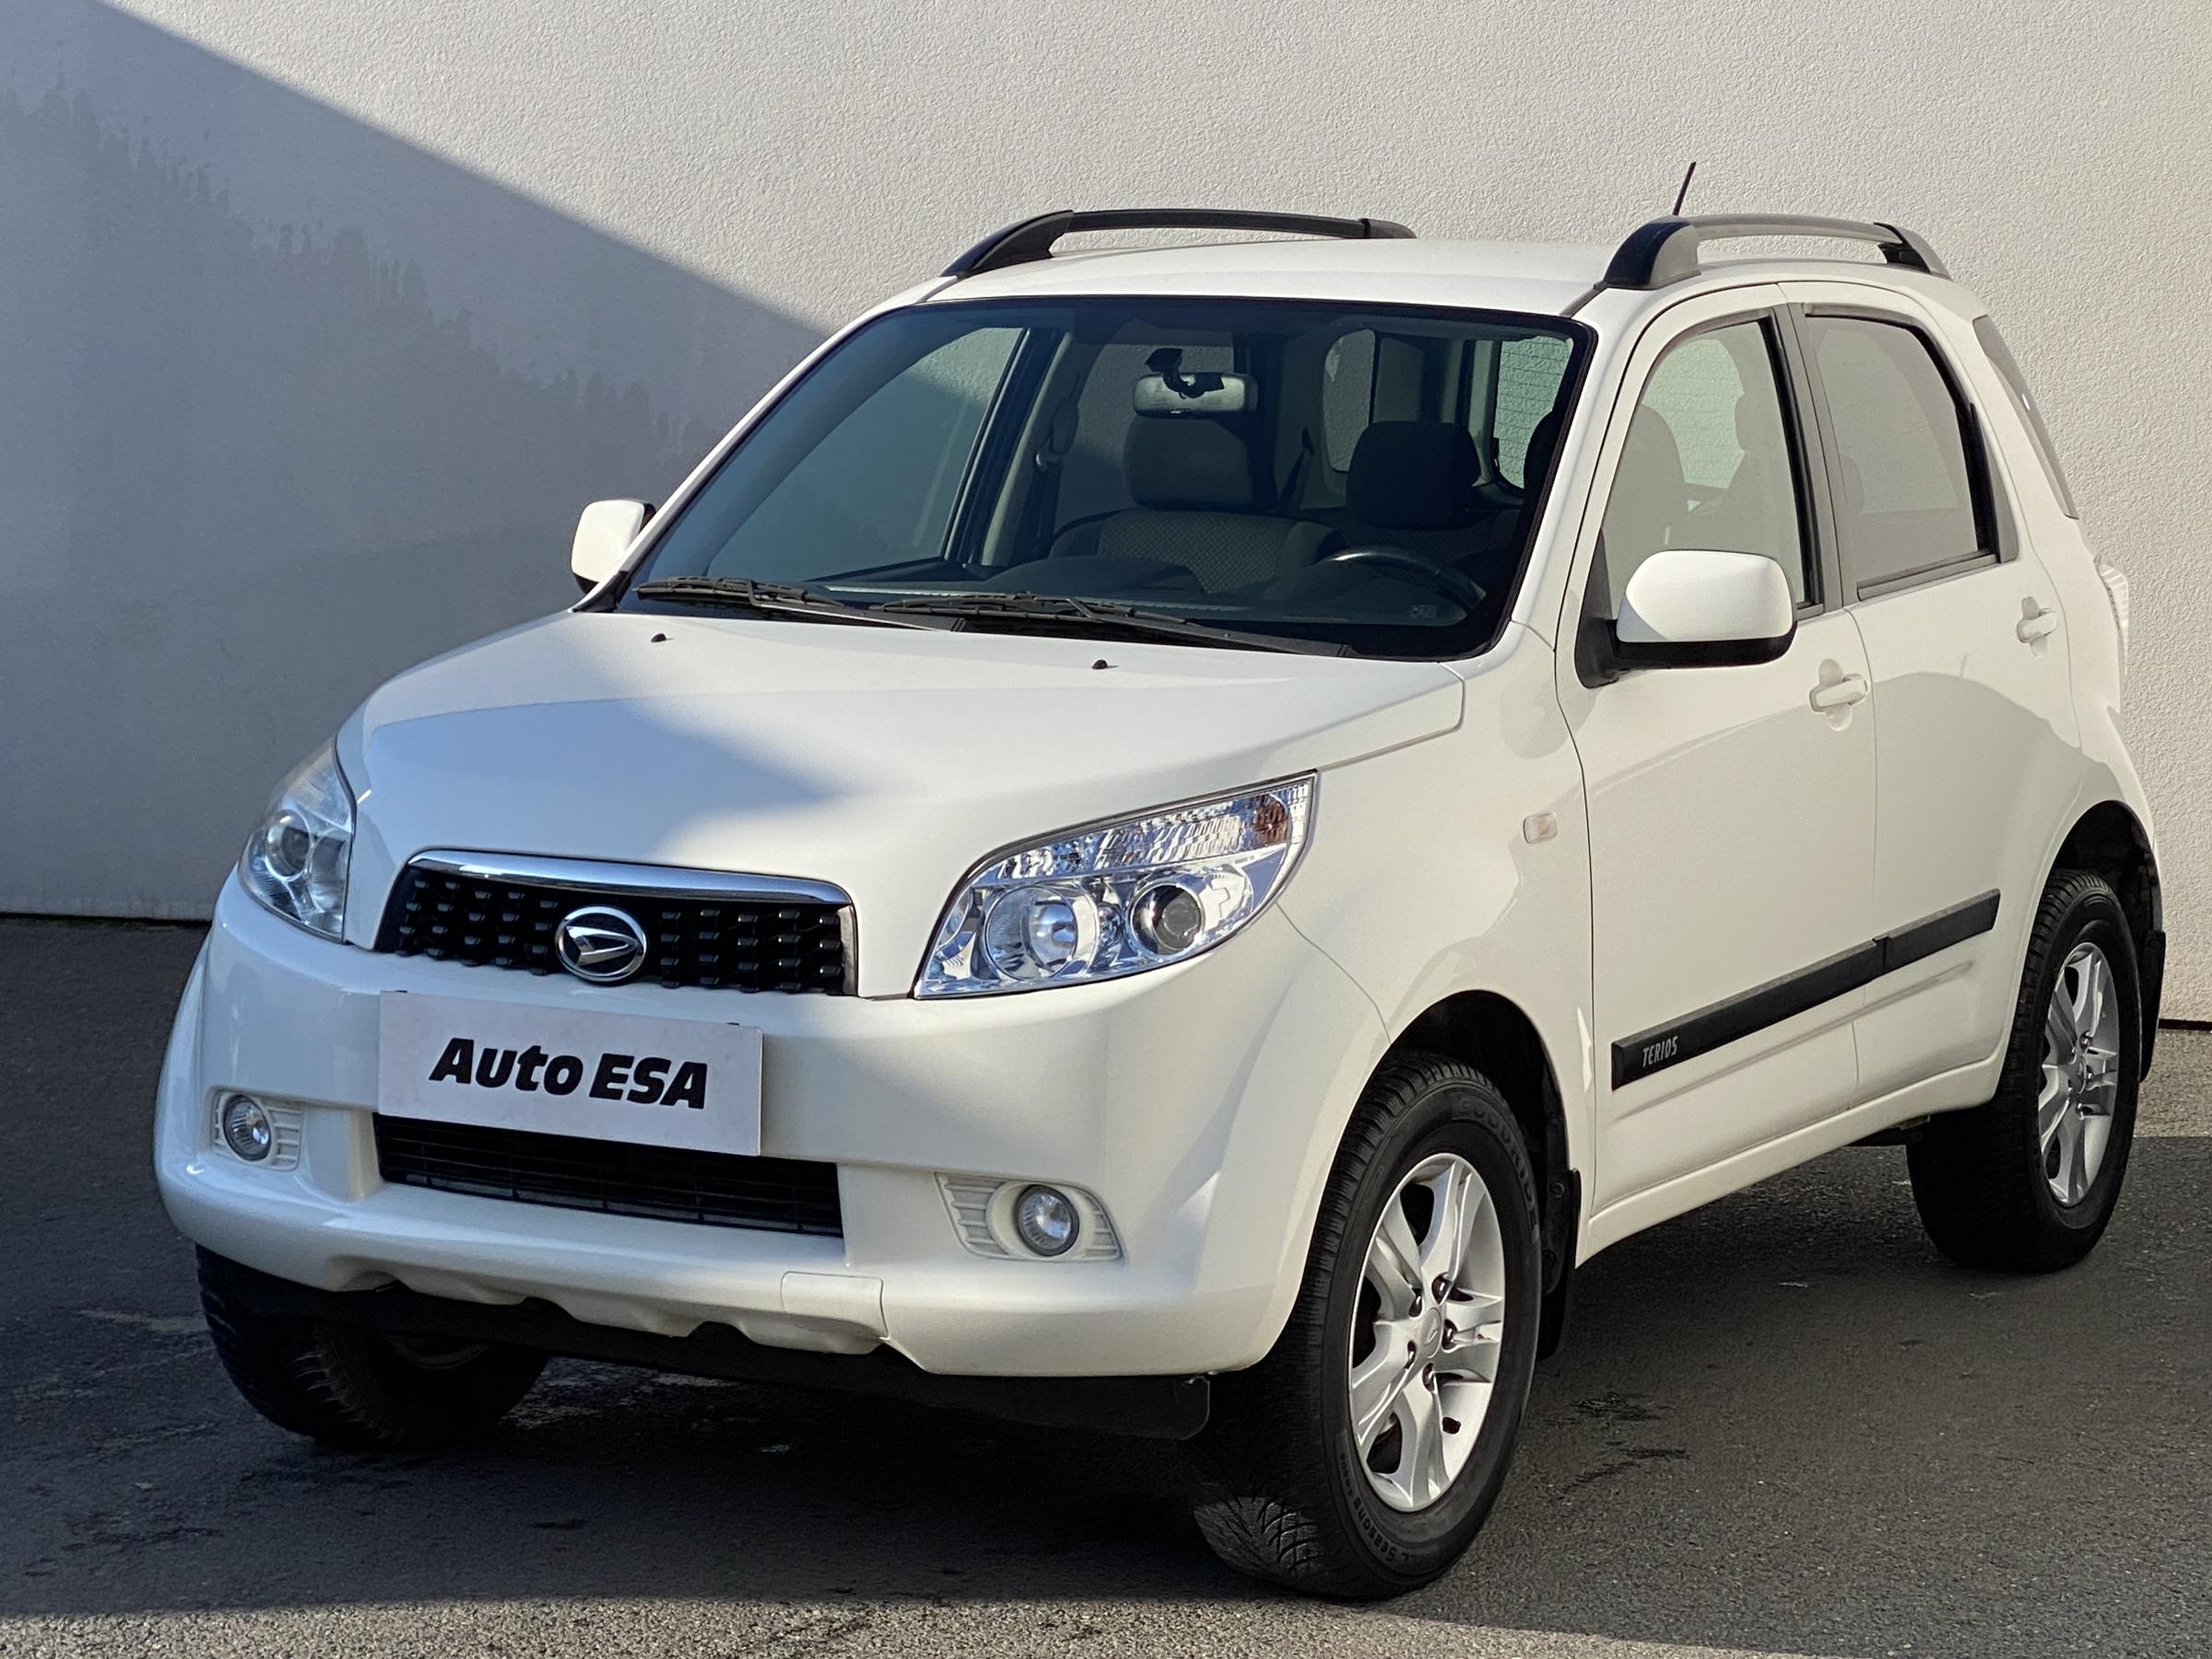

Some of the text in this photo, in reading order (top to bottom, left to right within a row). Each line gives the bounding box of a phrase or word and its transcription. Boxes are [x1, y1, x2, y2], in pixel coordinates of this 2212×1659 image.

[429, 1038, 708, 1110] Auto ESA
[1642, 1035, 1678, 1067] TERIOS
